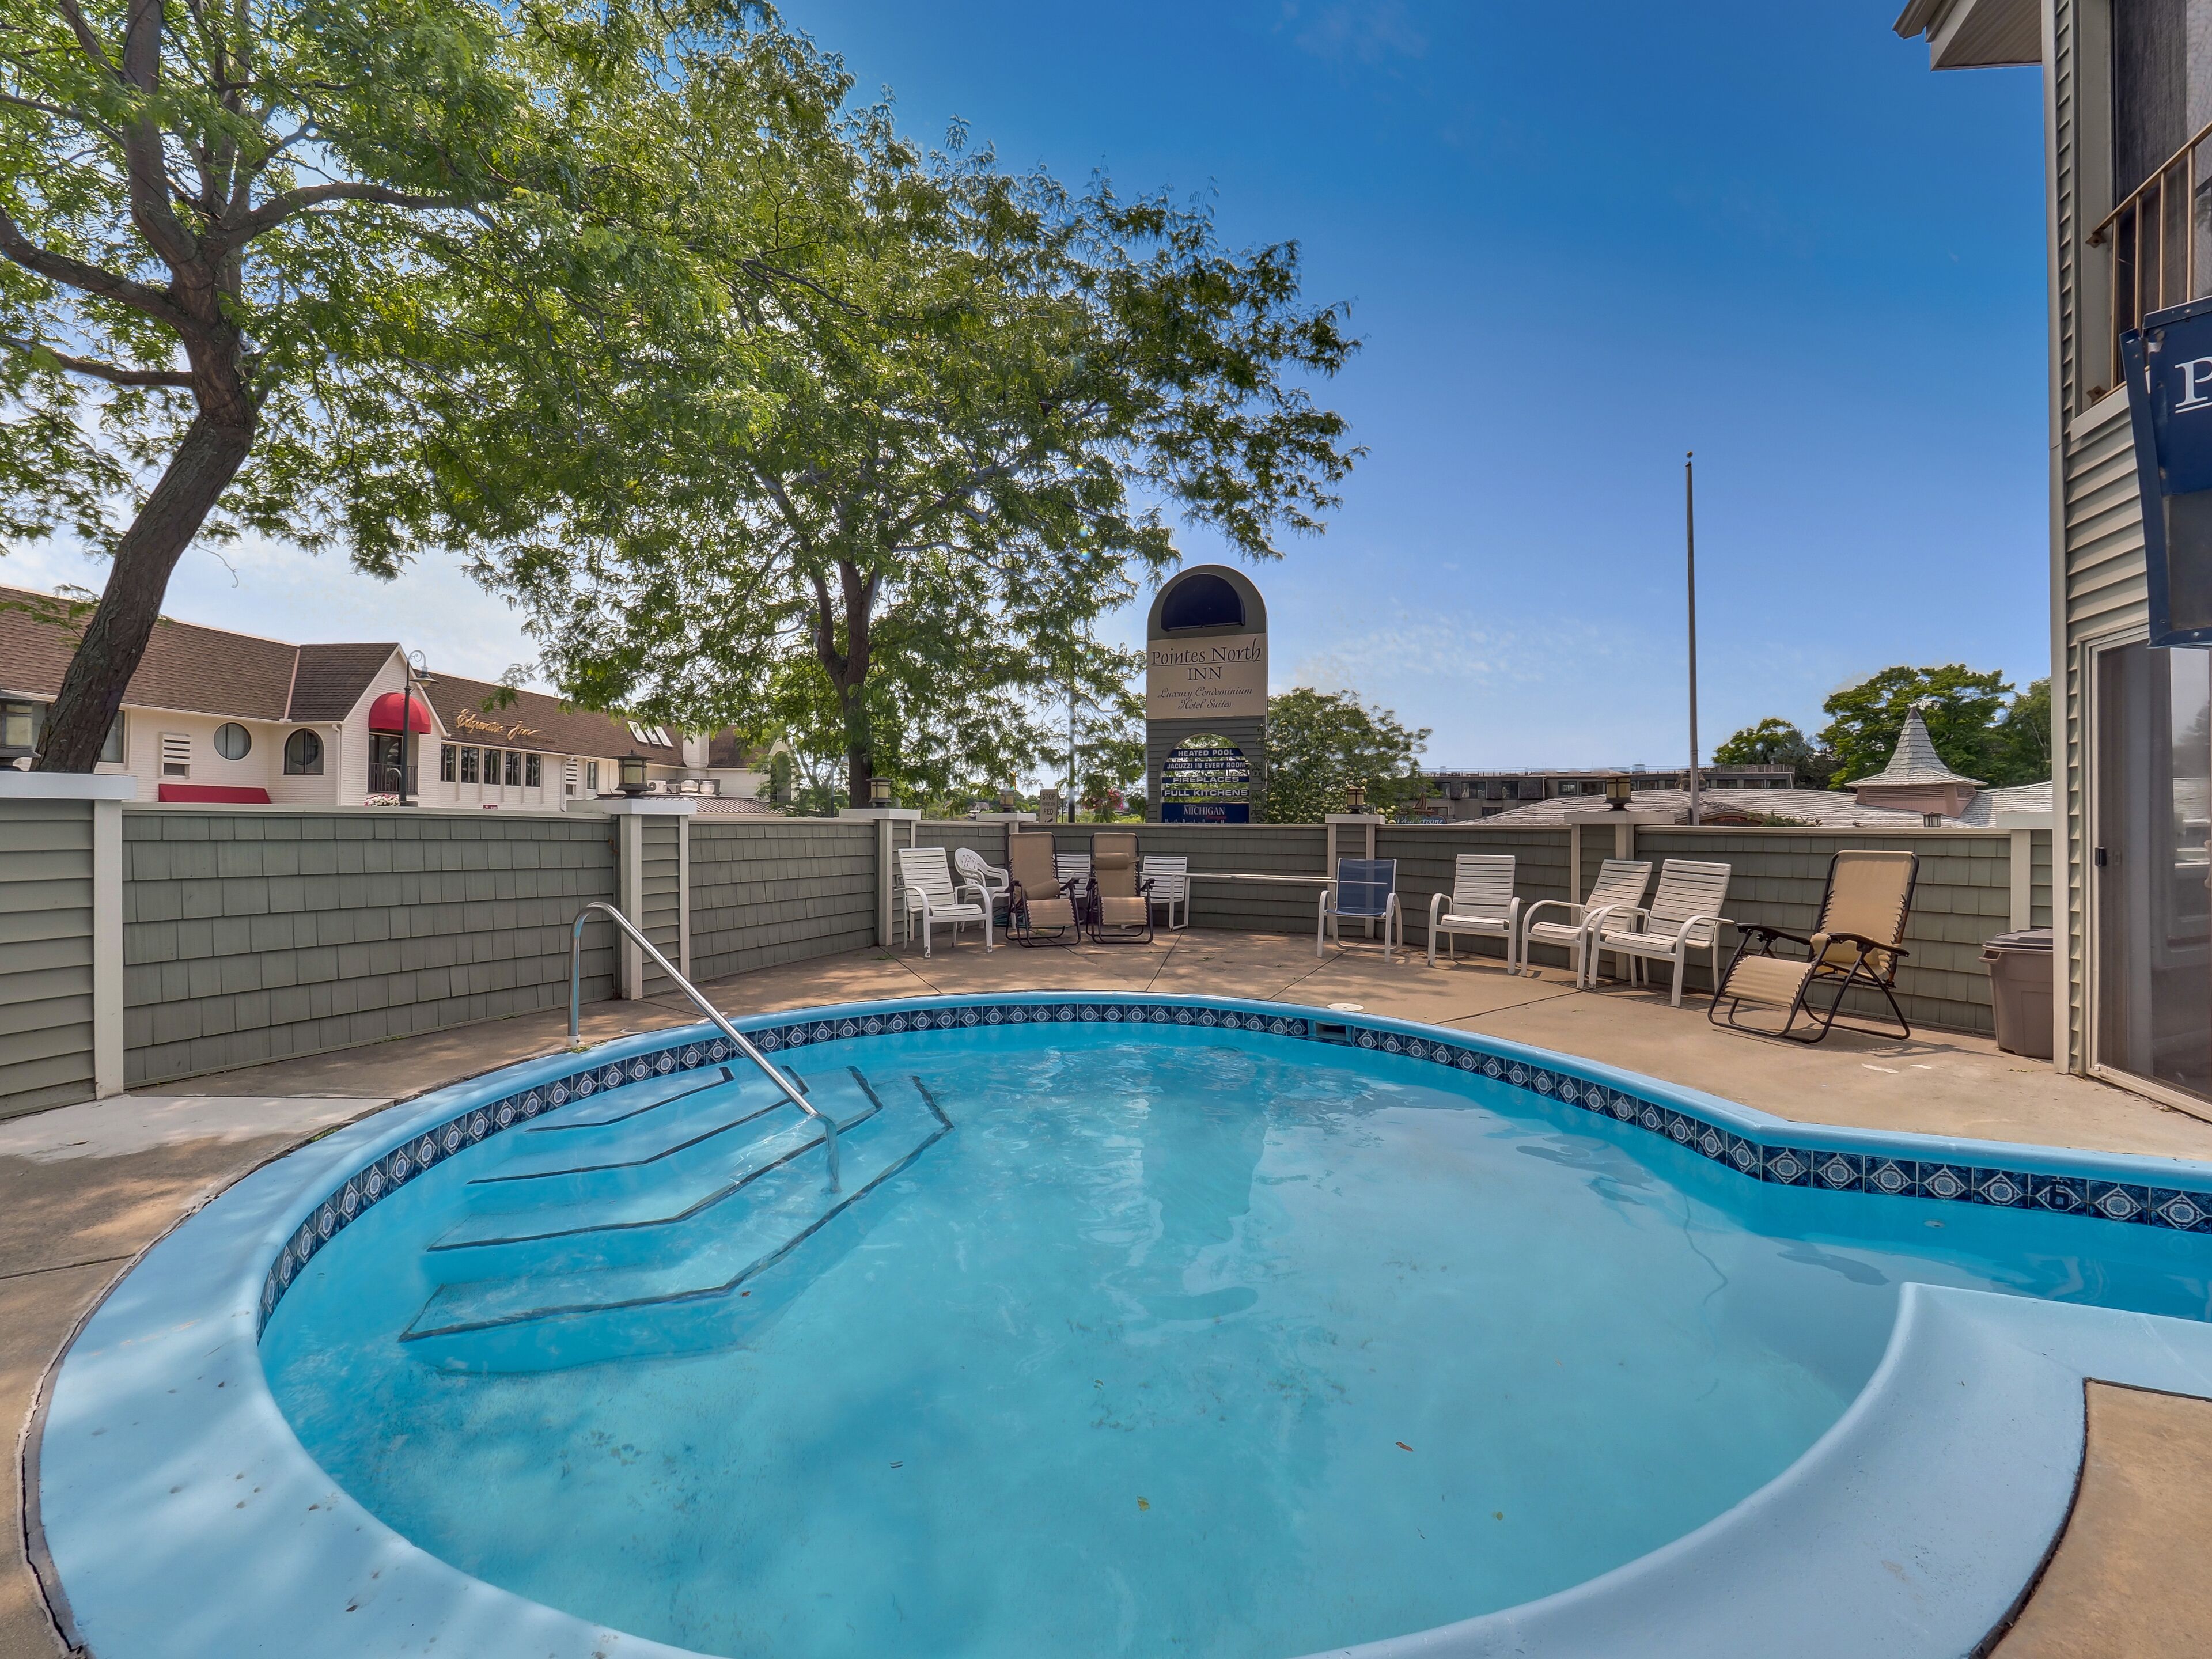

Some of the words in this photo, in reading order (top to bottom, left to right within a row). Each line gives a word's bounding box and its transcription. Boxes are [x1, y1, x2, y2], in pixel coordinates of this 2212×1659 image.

[1152, 647, 1205, 665] Pointes
[1211, 638, 1261, 662] North
[1187, 666, 1222, 680] INN
[1157, 688, 1192, 700] Luxury
[1195, 686, 1252, 696] Condominium
[1178, 699, 1206, 709] Hotel
[1207, 698, 1232, 709] Suites
[1184, 806, 1225, 815] MICHIGAN
[2049, 1180, 2071, 1210] 6
